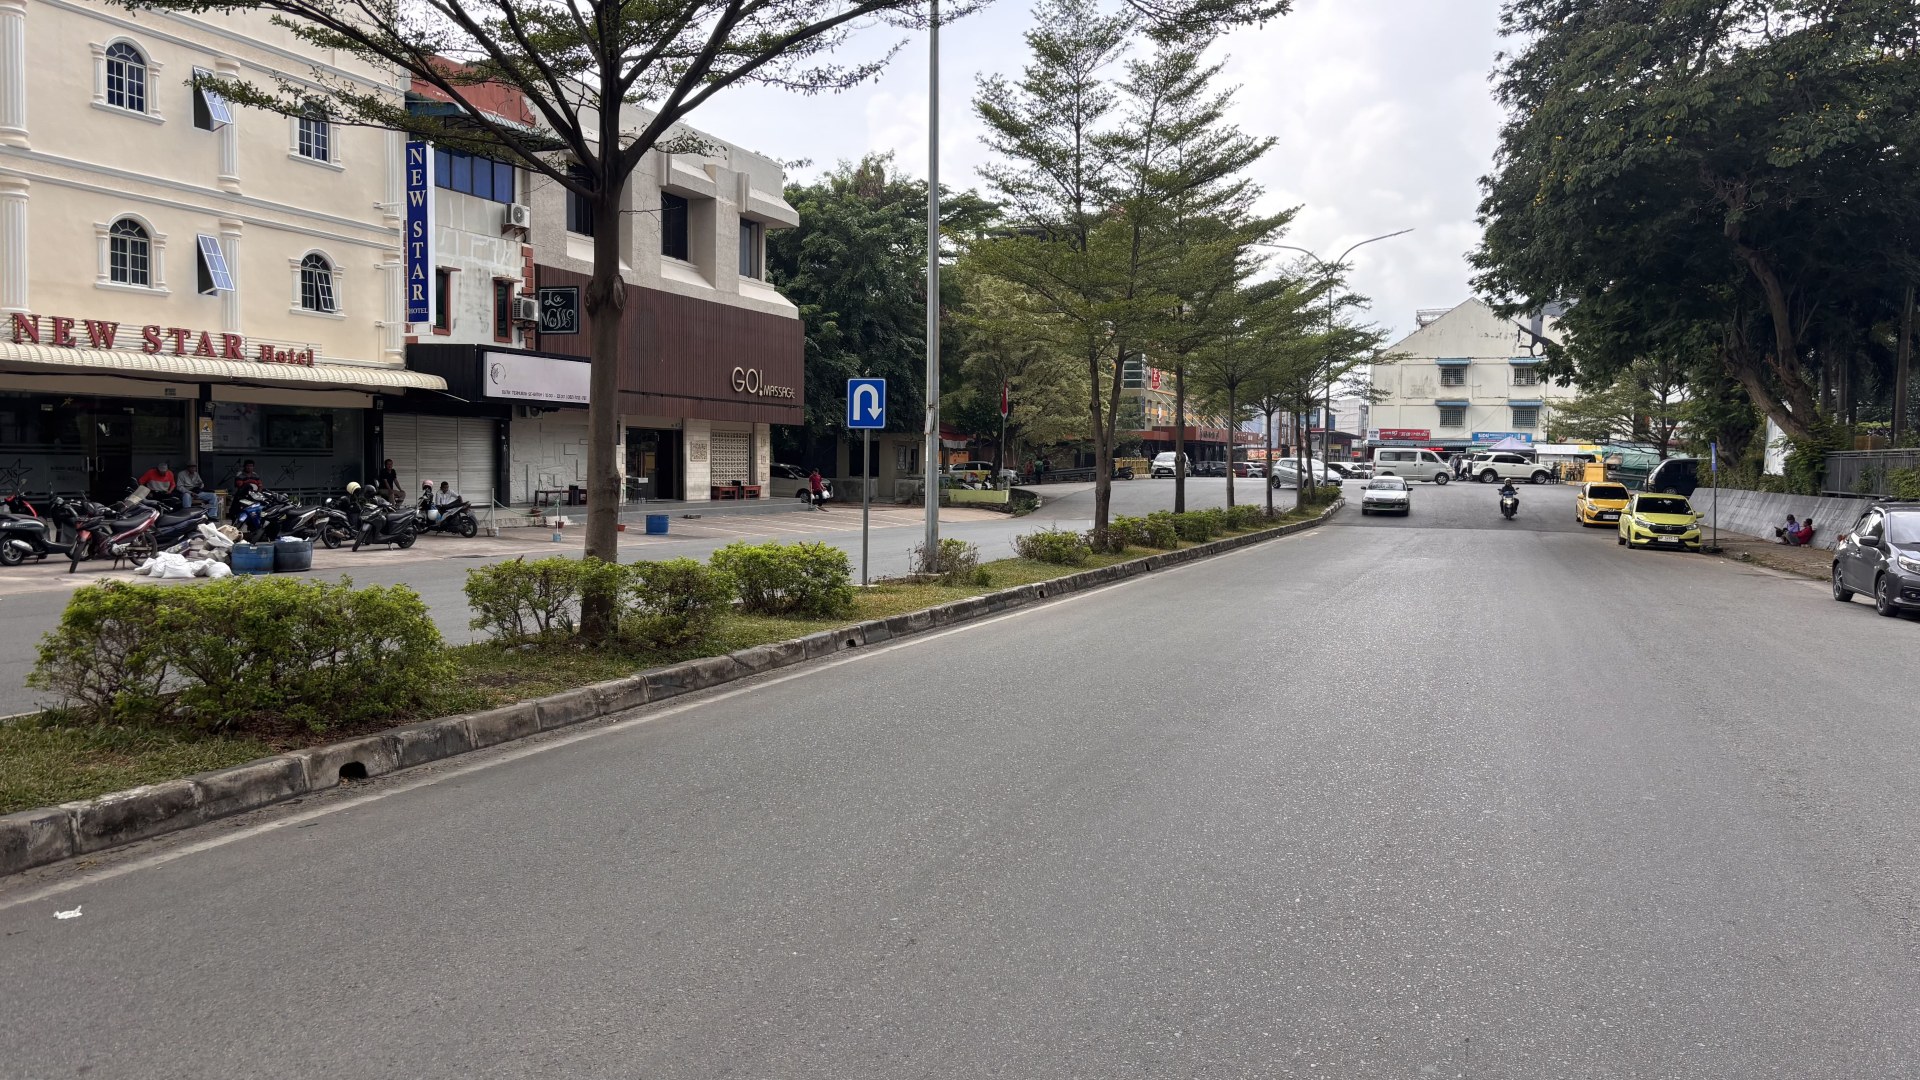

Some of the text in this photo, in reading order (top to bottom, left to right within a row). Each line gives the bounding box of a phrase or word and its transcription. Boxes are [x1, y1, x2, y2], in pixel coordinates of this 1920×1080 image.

[408, 147, 427, 301] NEW STAR
[10, 312, 315, 367] NEW STAR Hotel
[732, 366, 796, 398] GO! MASSAGE
